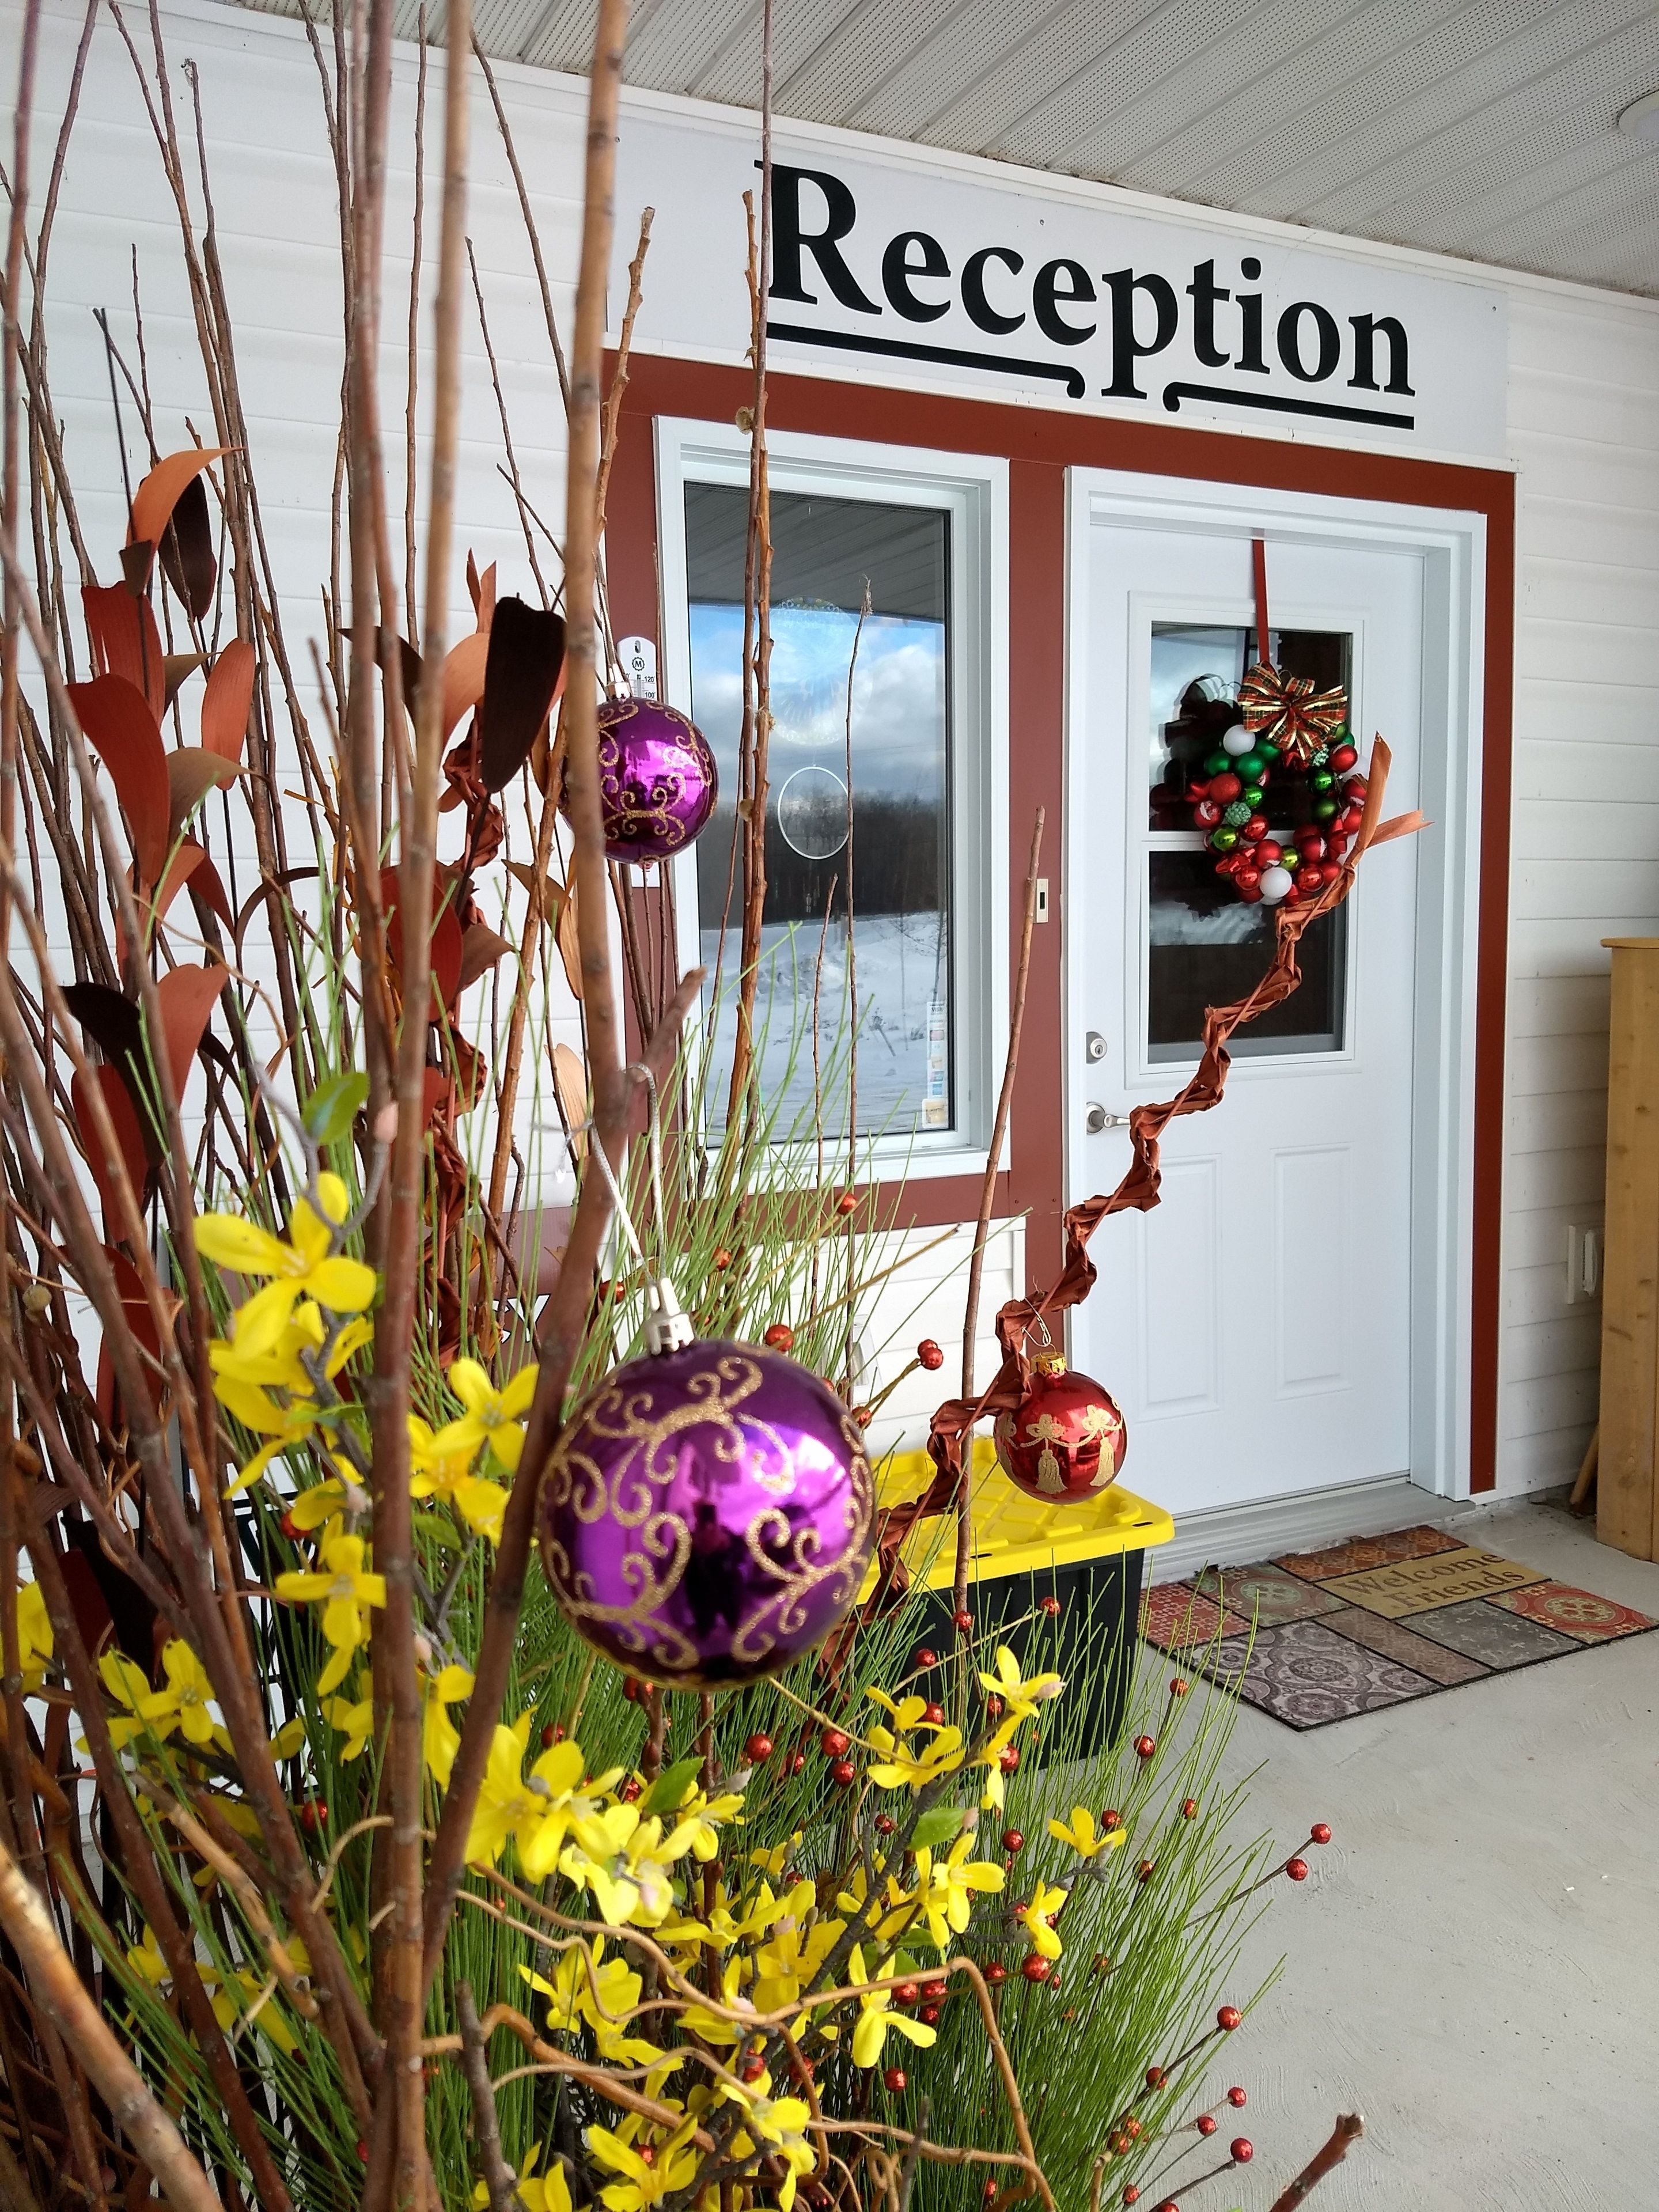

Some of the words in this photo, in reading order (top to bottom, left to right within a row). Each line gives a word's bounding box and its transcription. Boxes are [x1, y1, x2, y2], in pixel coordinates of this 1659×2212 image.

[754, 160, 1415, 400] Reception
[1334, 1554, 1506, 1595] Welcome
[1384, 1570, 1525, 1609] Friends
